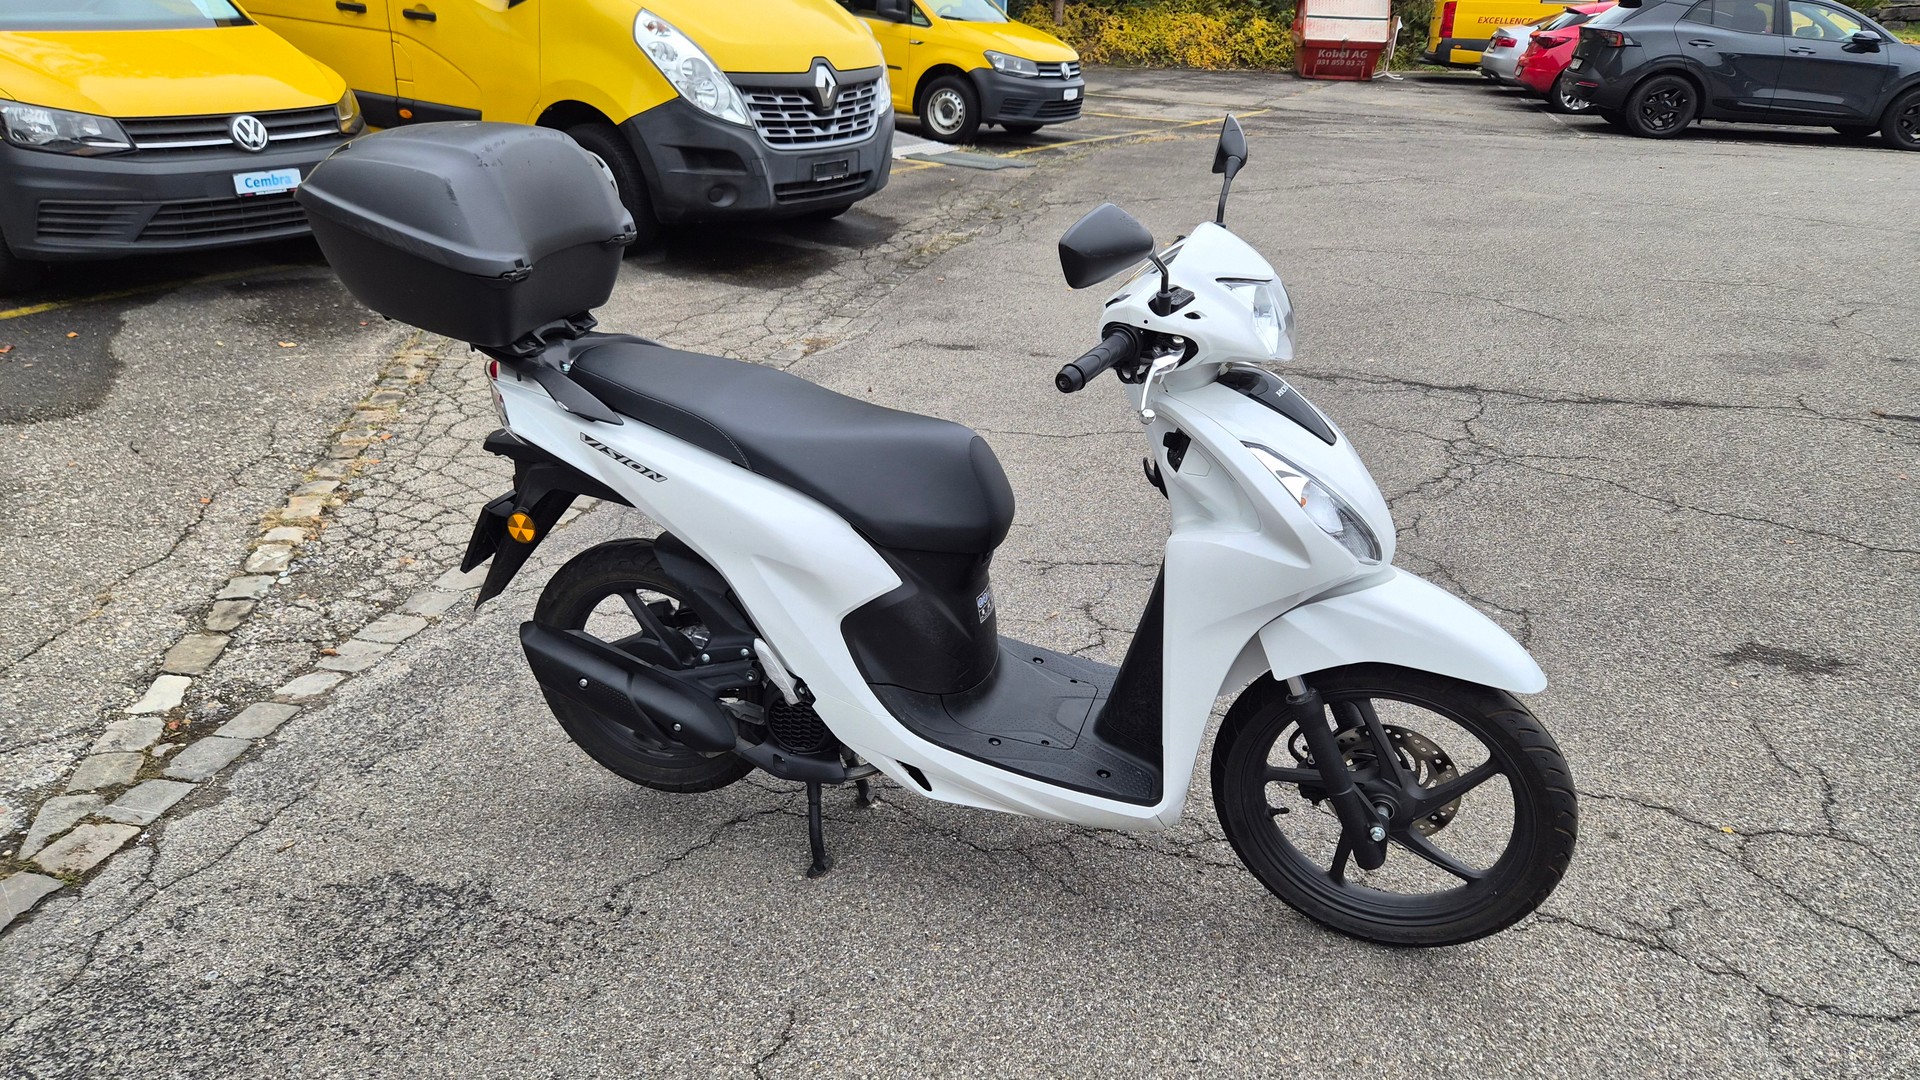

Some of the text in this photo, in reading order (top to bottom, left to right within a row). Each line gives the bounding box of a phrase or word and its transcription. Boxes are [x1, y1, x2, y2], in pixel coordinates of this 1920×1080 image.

[1317, 48, 1369, 59] Kobel AG
[244, 173, 292, 189] Cembra
[580, 431, 668, 483] VISION
